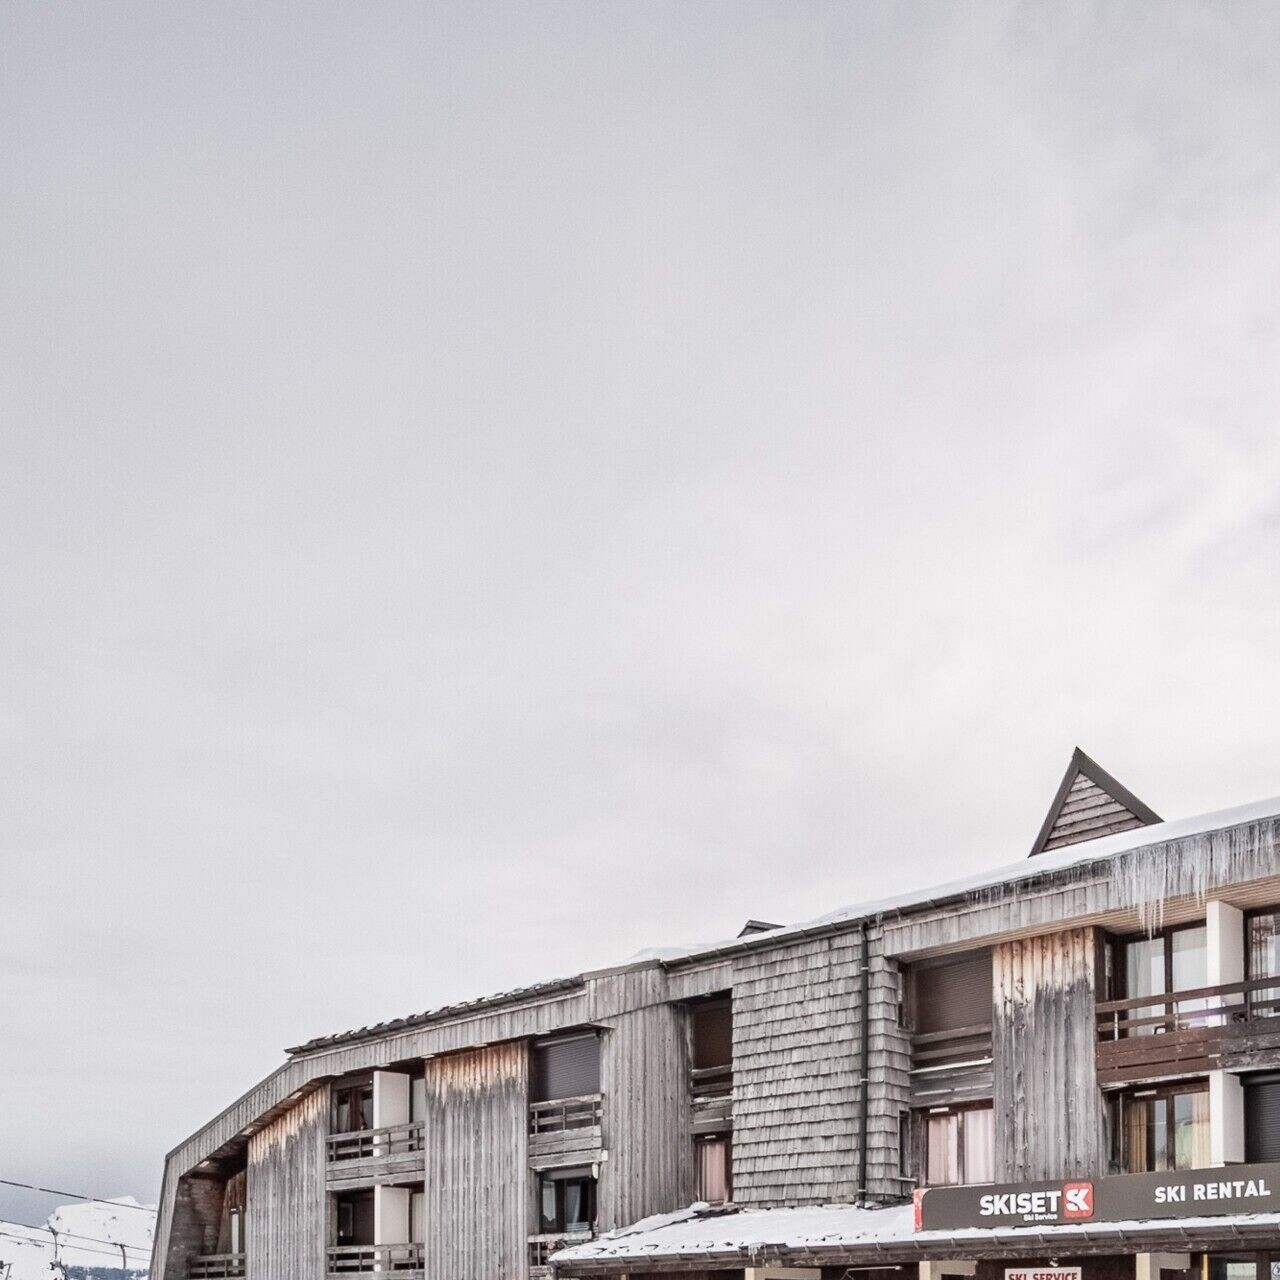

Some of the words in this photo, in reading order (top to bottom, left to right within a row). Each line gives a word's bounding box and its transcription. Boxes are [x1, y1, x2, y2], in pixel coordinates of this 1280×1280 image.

[979, 1190, 1062, 1216] SKISET
[1154, 1184, 1186, 1203] SKI
[1193, 1180, 1270, 1201] RENTAL
